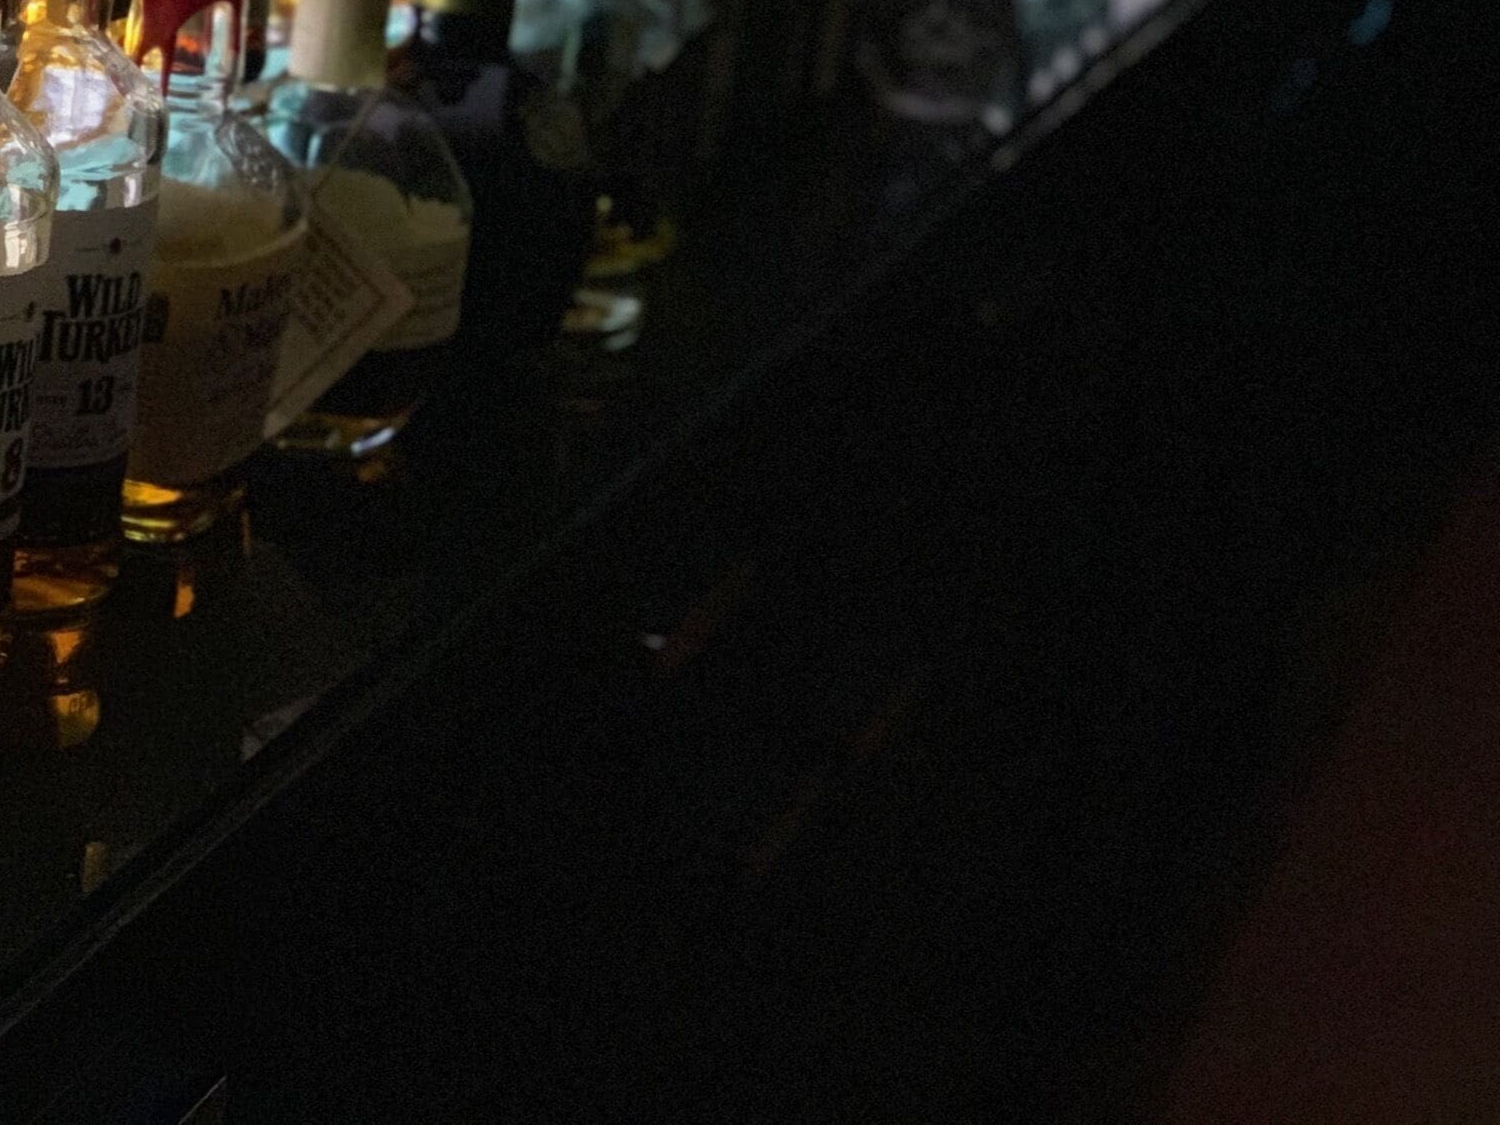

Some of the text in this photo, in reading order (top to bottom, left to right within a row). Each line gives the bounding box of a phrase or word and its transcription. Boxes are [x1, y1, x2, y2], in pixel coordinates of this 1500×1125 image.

[67, 271, 141, 319] WILD
[74, 374, 116, 416] 13
[1, 437, 24, 492] 8
